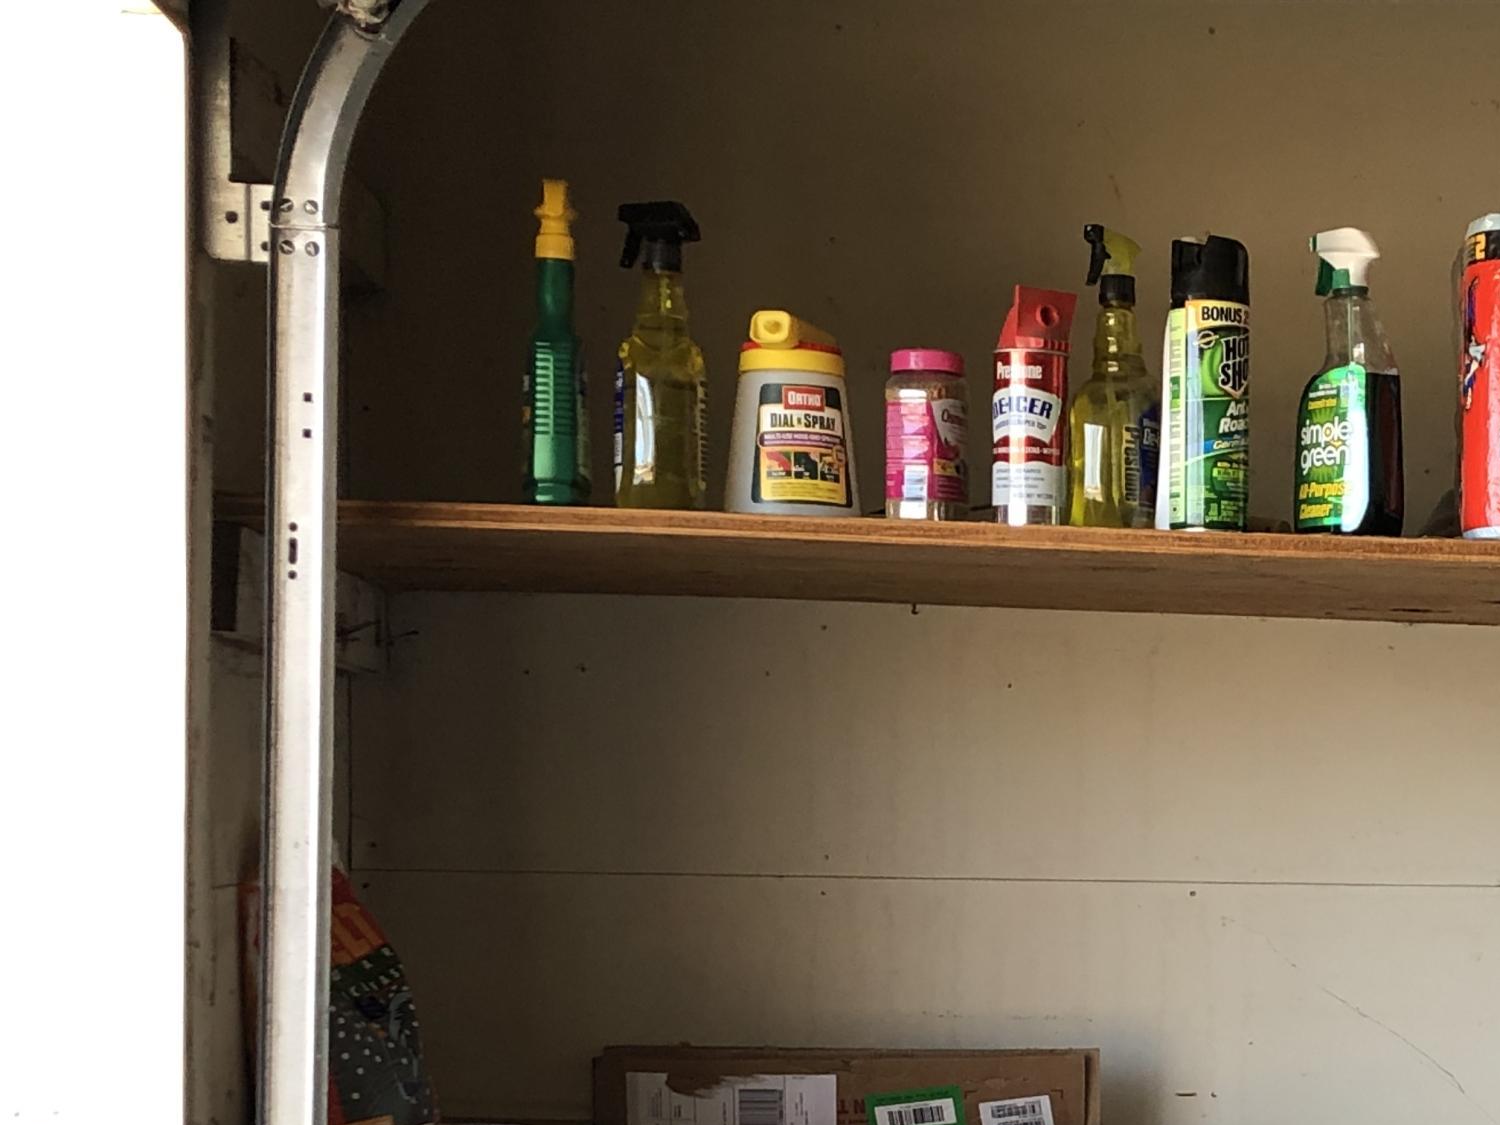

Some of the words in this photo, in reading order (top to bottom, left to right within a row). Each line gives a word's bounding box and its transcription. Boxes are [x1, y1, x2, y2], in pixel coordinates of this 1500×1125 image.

[1201, 306, 1242, 323] BONUS
[1223, 338, 1249, 362] HO
[1220, 359, 1249, 391] SHO
[787, 391, 823, 406] ORTHO
[770, 413, 796, 428] DIAL
[804, 413, 836, 430] SPRAY
[1300, 416, 1352, 447] simple
[1300, 445, 1350, 476] green
